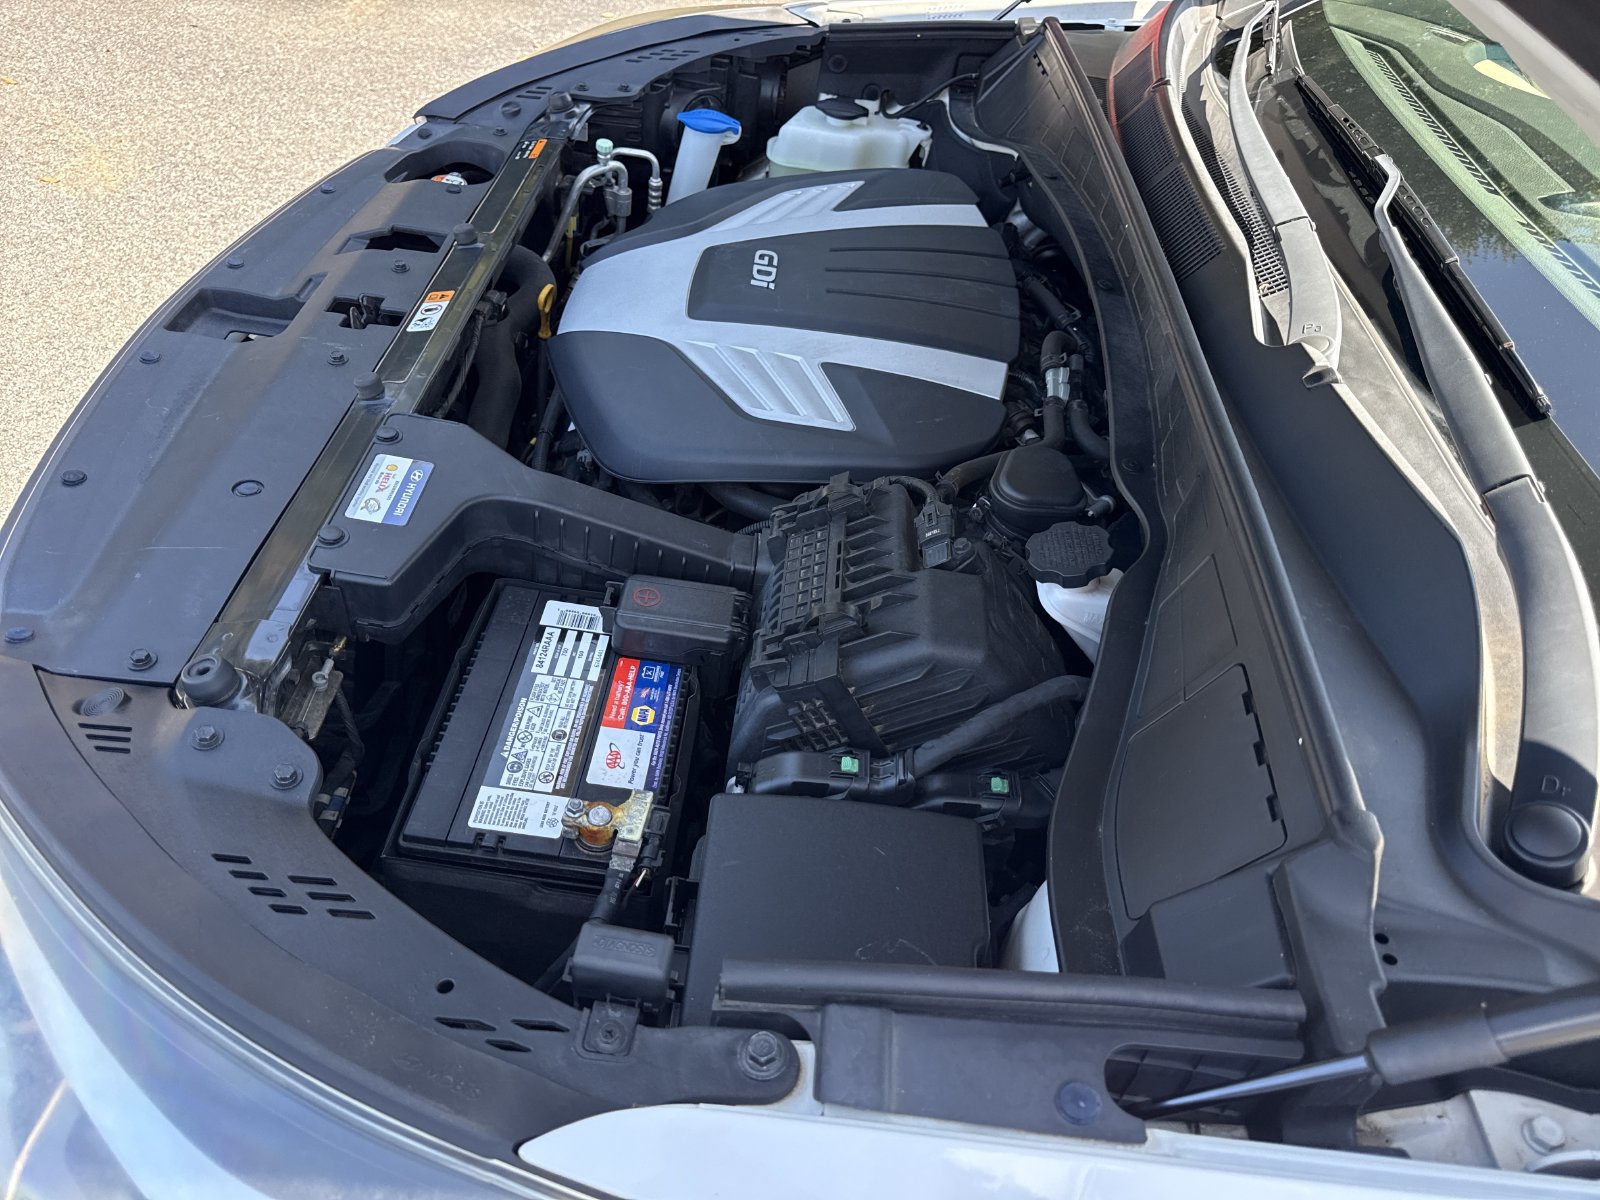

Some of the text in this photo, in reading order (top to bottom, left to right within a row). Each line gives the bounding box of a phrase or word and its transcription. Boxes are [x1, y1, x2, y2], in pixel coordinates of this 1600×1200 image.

[751, 250, 778, 290] GDi
[375, 472, 392, 493] HELIX
[392, 482, 417, 516] HYUNDAI
[535, 630, 555, 668] 84124RAAA
[608, 704, 618, 719] Need
[613, 679, 625, 700] battery?
[617, 665, 637, 720] Call: 800-AAA-HELP
[503, 697, 527, 750] DANGER/POISON
[636, 707, 650, 722] NAPA
[604, 750, 621, 768] AAA
[627, 766, 637, 784] Power
[636, 733, 644, 746] trust
[1541, 775, 1572, 797] Dr
